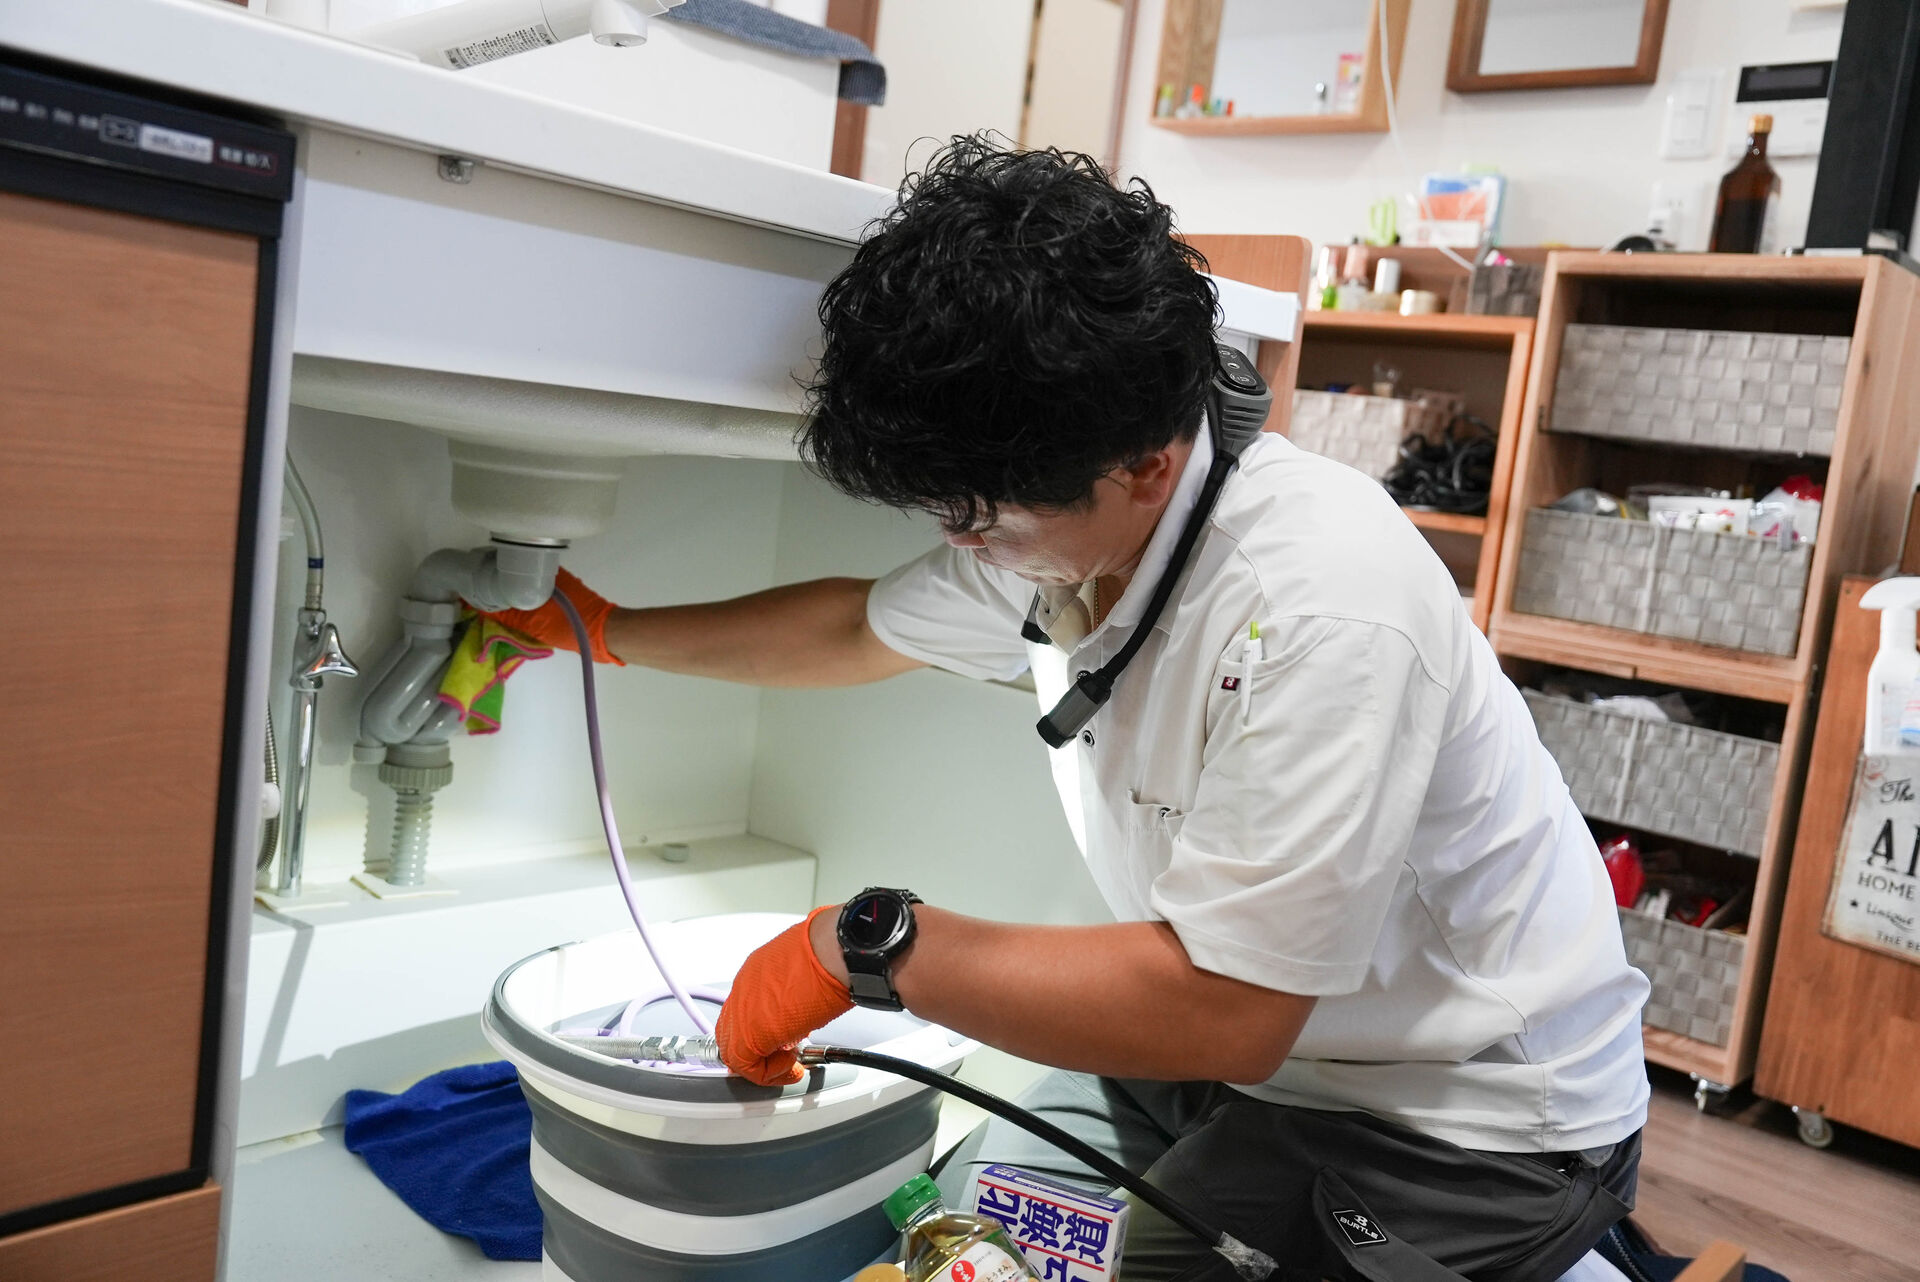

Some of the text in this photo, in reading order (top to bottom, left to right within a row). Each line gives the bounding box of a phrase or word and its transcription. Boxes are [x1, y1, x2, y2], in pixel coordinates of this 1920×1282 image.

[1880, 778, 1915, 804] The
[1858, 872, 1916, 900] HOME
[977, 1187, 1109, 1265] 北海道
[1340, 1216, 1378, 1239] BURTLE
